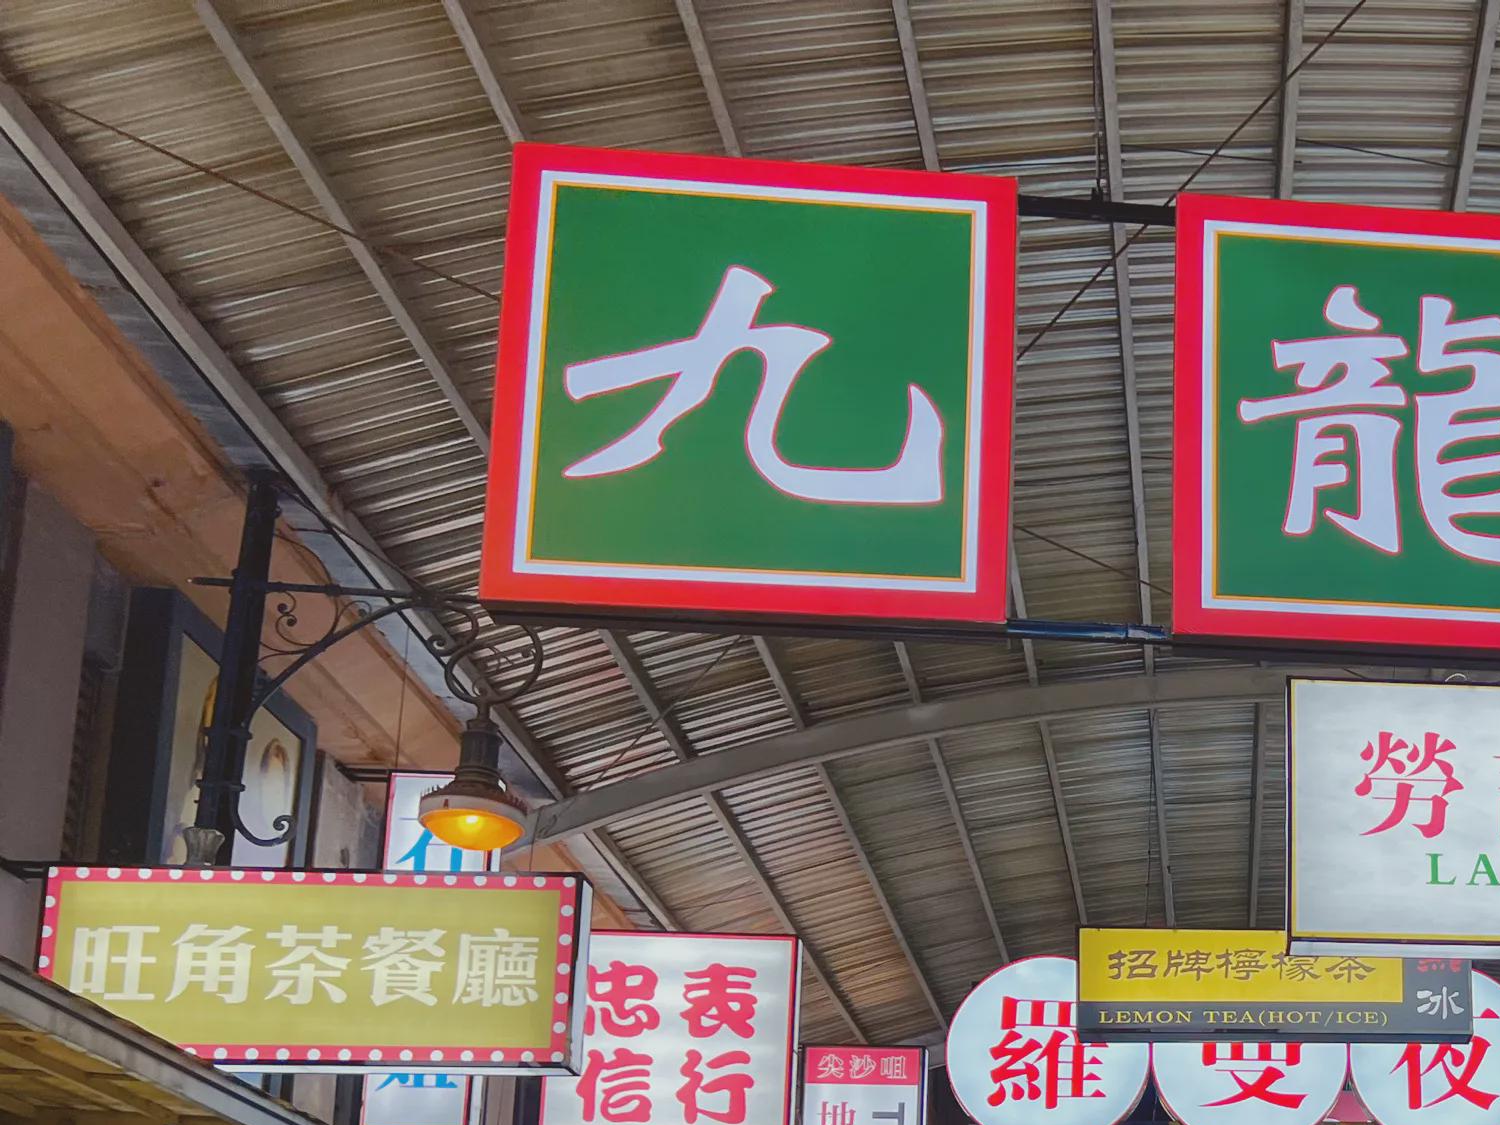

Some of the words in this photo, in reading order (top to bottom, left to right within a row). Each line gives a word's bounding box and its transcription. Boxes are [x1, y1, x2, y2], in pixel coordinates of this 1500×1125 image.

[68, 923, 540, 1008] 旺角茶餐廳
[1107, 948, 1376, 983] 招牌檸檬茶
[1099, 1009, 1193, 1025] LEMON
[1203, 1008, 1390, 1028] TEA(HOT/ICE)
[816, 1054, 908, 1080] 尖沙咀
